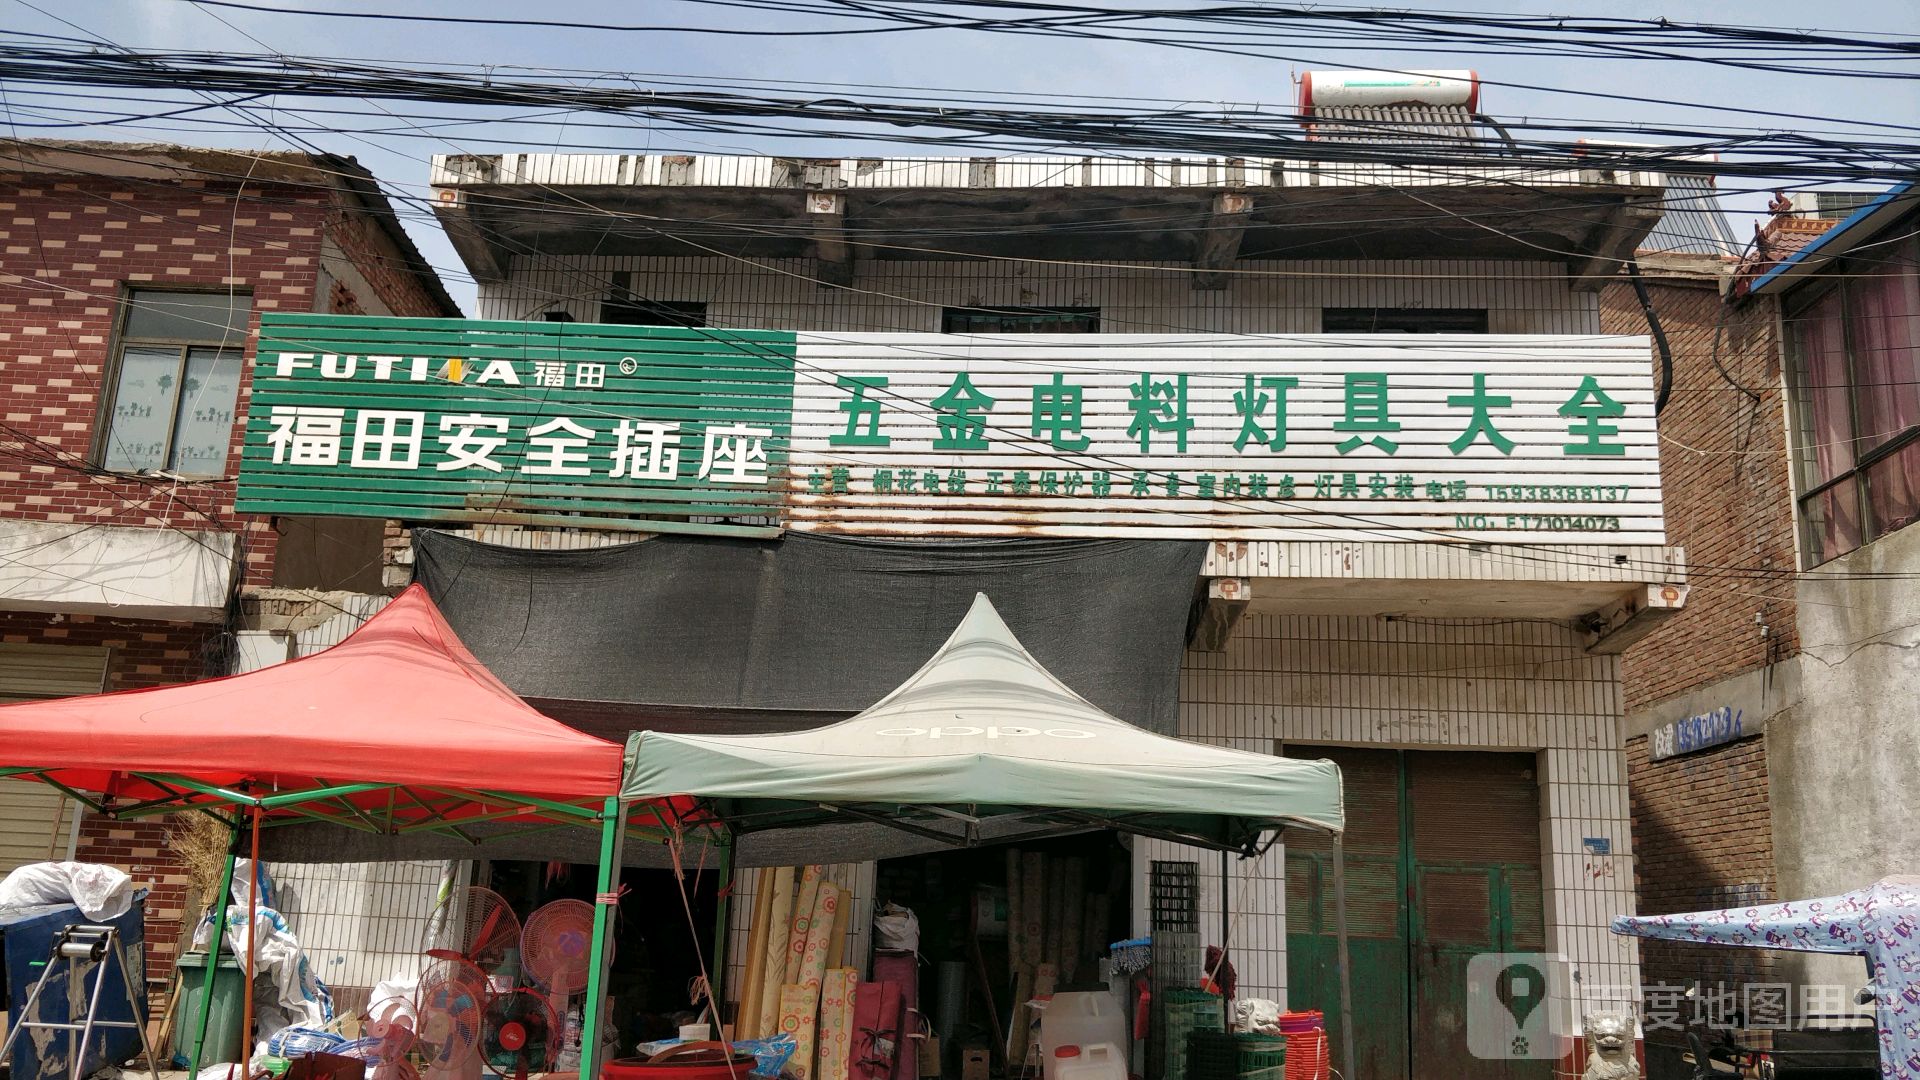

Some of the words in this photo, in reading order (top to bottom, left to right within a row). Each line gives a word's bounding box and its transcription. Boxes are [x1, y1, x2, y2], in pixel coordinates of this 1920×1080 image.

[534, 361, 606, 388] 福田
[829, 372, 1627, 455] 五金电料灯具大全
[266, 406, 773, 484] 福田安全插座
[808, 468, 850, 494] 主营
[985, 470, 1111, 498] 正泰保护器
[1314, 473, 1415, 499] 灯具安装
[1485, 485, 1629, 501] 15938388137
